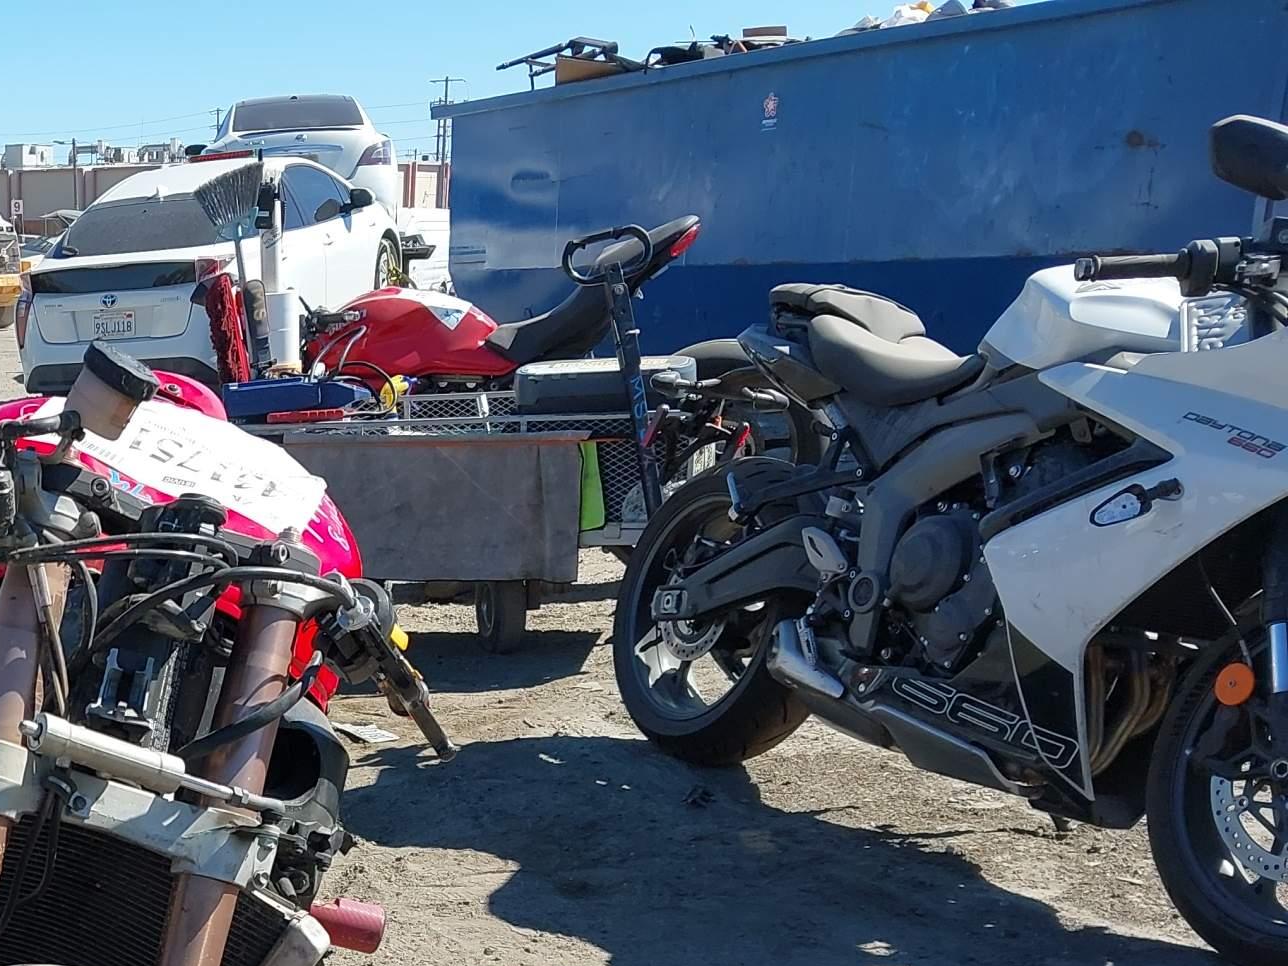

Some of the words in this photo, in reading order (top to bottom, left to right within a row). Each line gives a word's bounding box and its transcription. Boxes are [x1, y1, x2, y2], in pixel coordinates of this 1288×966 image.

[14, 201, 21, 212] 9
[95, 320, 132, 335] 9SLJ118
[1227, 436, 1277, 459] 660
[891, 677, 1080, 769] 660
